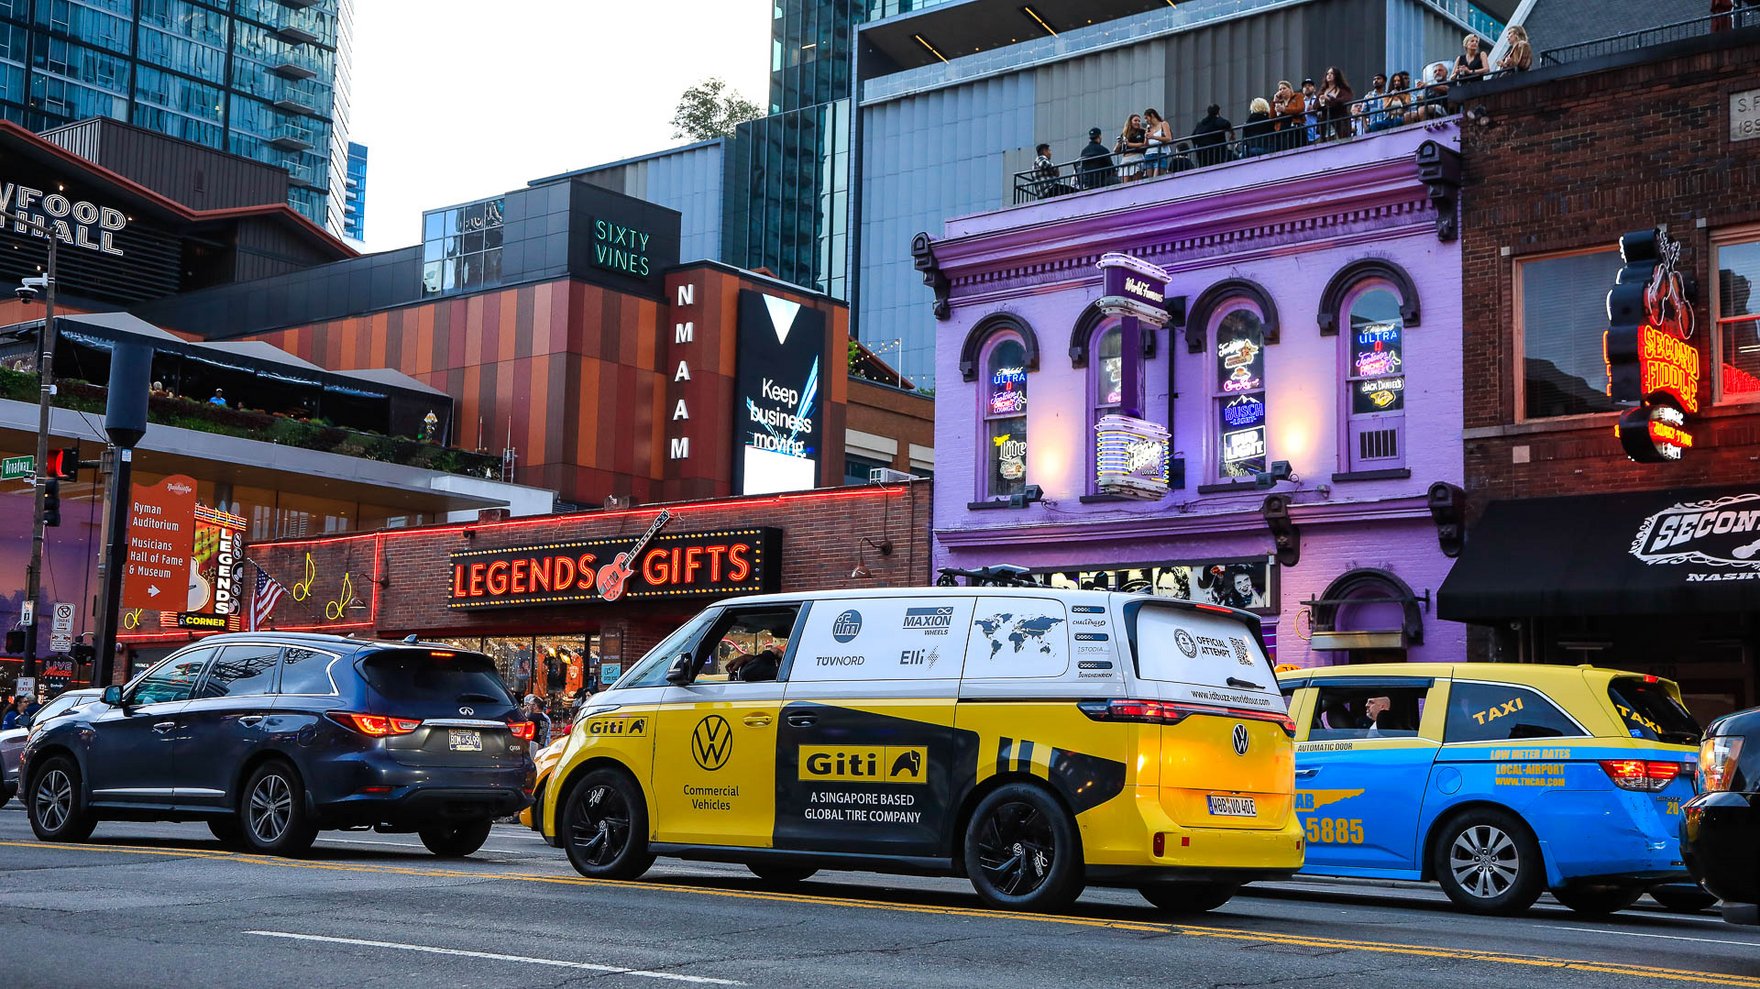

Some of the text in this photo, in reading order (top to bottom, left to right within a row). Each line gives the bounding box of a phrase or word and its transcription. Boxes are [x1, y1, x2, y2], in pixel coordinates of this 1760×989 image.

[16, 184, 127, 231] FOOD
[14, 209, 124, 256] HALL
[596, 220, 649, 250] SIXTY
[595, 244, 649, 276] VINES
[1359, 331, 1398, 344] ULTRA
[1644, 325, 1700, 381] SECOND
[670, 284, 694, 459] NMAAM
[993, 373, 1026, 385] ULTRA
[762, 378, 798, 408] Keep
[1646, 360, 1698, 413] FIDDLE
[750, 401, 812, 434] business
[1224, 402, 1264, 421] BUSCH
[753, 432, 807, 458] moving.
[5, 459, 30, 474] Broadway
[134, 502, 161, 515] Ryman
[132, 517, 179, 532] Auditorium
[1649, 510, 1760, 553] SECON
[131, 537, 172, 551] Musicians
[130, 551, 183, 567] Hall of Fame
[128, 564, 171, 578] & Museum
[215, 527, 234, 615] LEGENDS
[454, 543, 751, 598] LEGENDS GIFTS
[186, 616, 226, 627] CORNER
[903, 616, 952, 627] MAXION
[1196, 635, 1228, 649] OFFICIAL
[900, 648, 925, 665] Elli
[1201, 646, 1231, 658] ATTEMPT
[1191, 690, 1271, 706] www.idbuzz-worldtour.com
[1472, 697, 1524, 726] TAXI
[1616, 704, 1663, 735] TAXI
[589, 720, 624, 734] Giti
[1297, 743, 1353, 752] AUTOMATIC DOOR
[1490, 748, 1571, 760] LOW METER RATES
[806, 752, 877, 776] Giti
[1495, 763, 1565, 775] LOCAL-AIRPORT
[683, 784, 740, 797] Commercial
[810, 791, 914, 806] A SINGAPORE BASED
[692, 799, 731, 810] Vehicles
[1241, 800, 1256, 815] 40E
[1295, 793, 1315, 809] AB
[1666, 801, 1679, 814] 20
[804, 808, 921, 823] GLOBAL TIRE COMPANY
[1306, 817, 1364, 844] 5885
